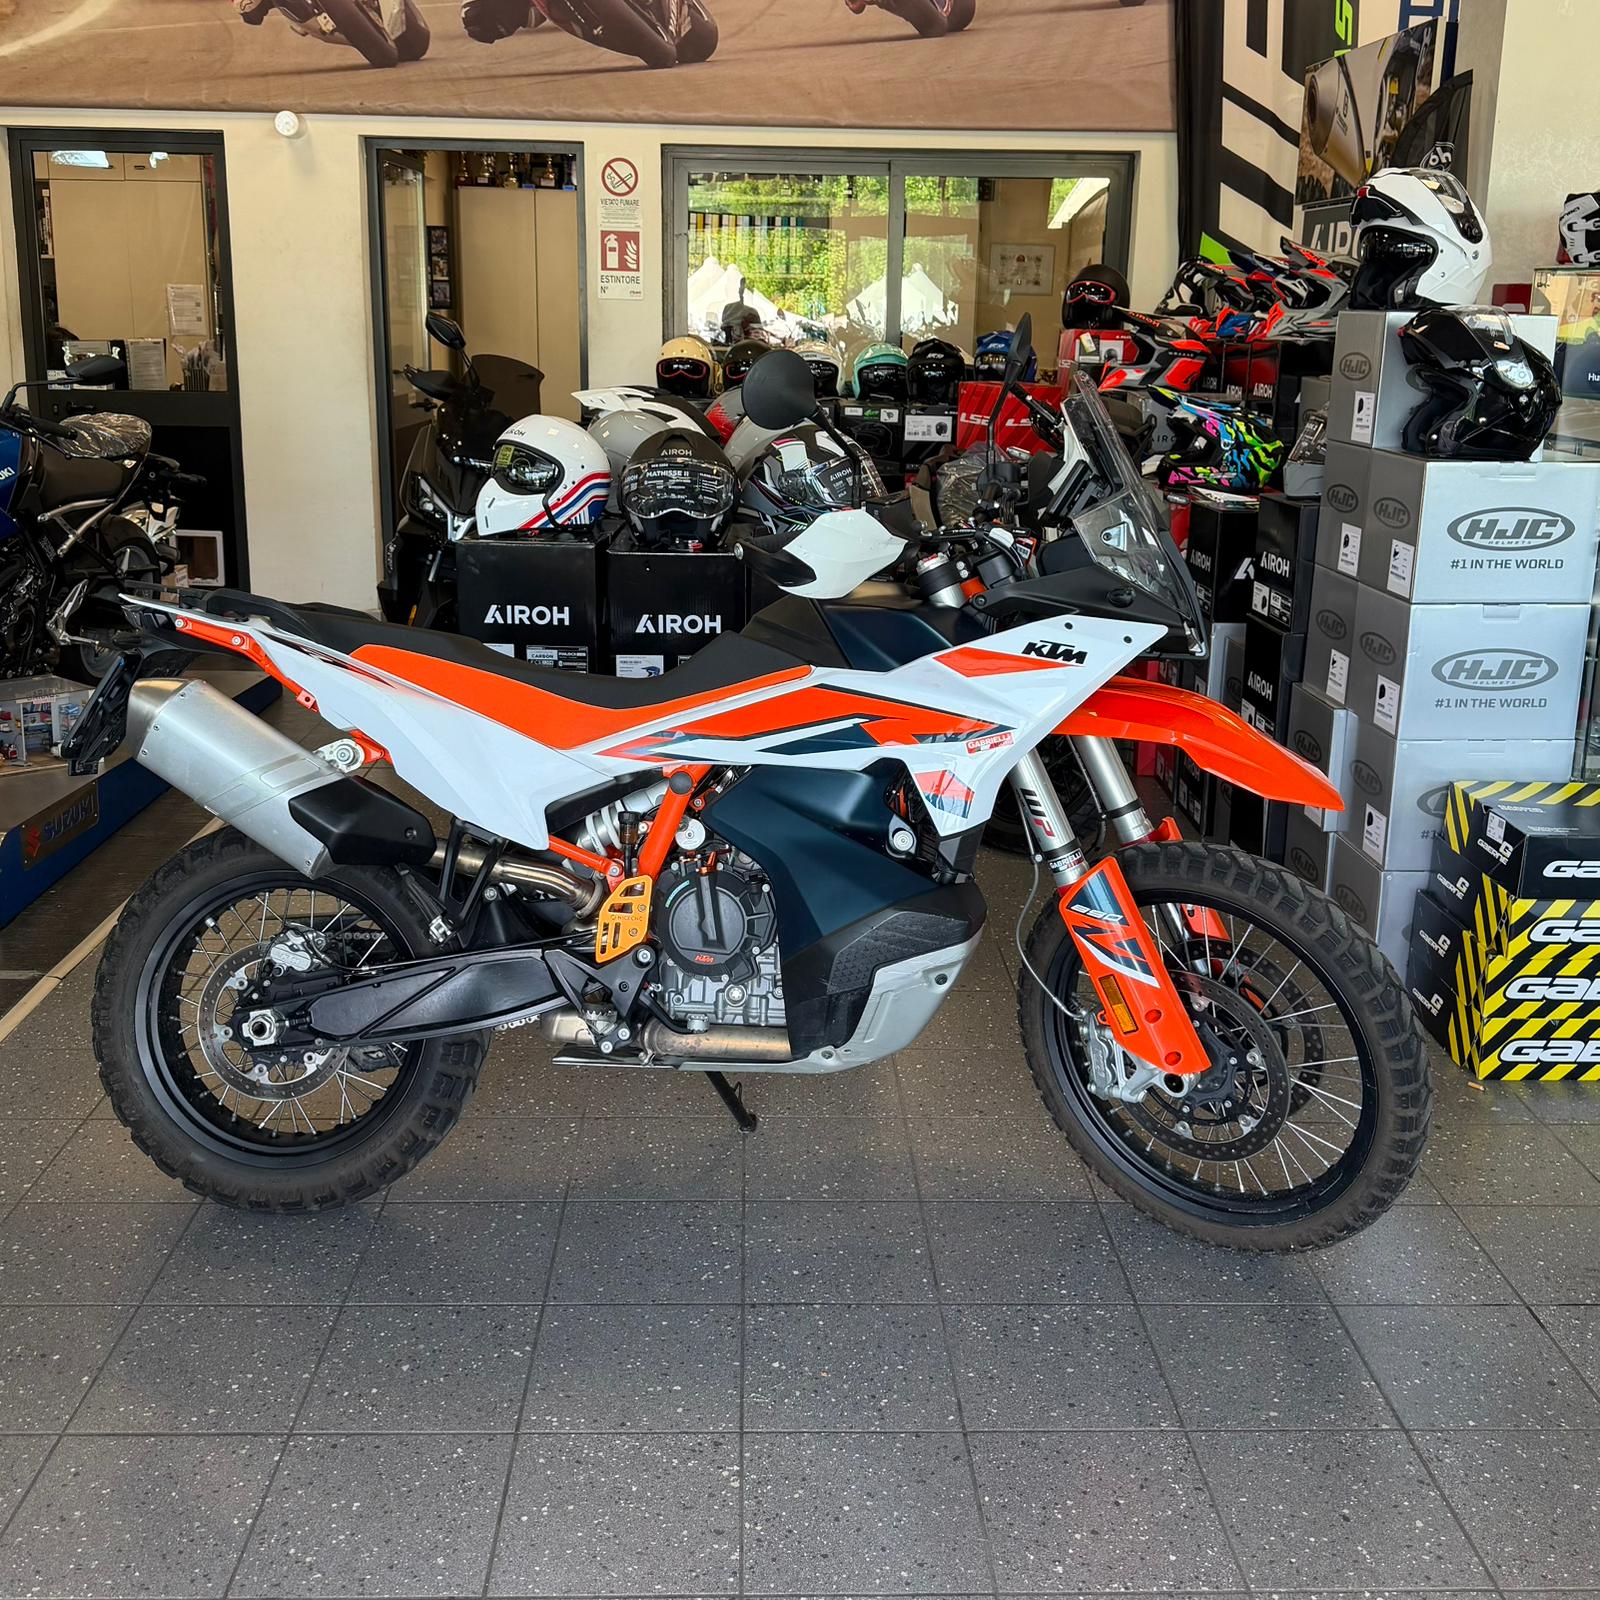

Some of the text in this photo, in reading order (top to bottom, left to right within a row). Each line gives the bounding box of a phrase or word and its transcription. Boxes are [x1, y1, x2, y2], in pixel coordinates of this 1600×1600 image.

[600, 275, 640, 284] ESTINTORE
[1342, 359, 1368, 374] HJC
[1252, 383, 1273, 399] AIROH
[660, 448, 692, 456] AIROH
[829, 468, 852, 482] AIROH
[1330, 489, 1355, 508] HJC
[1378, 503, 1406, 523] HJC
[1462, 518, 1560, 540] HJC
[1190, 549, 1212, 573] AIROH
[1260, 551, 1290, 578] AIROH
[1450, 559, 1564, 569] #1 IN THE WORLD
[484, 604, 570, 626] AIROH
[635, 614, 722, 634] AIROH
[1319, 614, 1344, 636] HJC
[1021, 640, 1088, 664] KTM
[1363, 636, 1392, 661] HJC
[1447, 659, 1544, 680] HJC
[1247, 671, 1273, 702] AIROH
[1435, 698, 1548, 708] #1 IN THE WORLD
[968, 733, 1012, 749] GABRIELLI
[1298, 734, 1319, 758] HJC
[1353, 763, 1380, 791] HJC
[43, 793, 95, 842] SUZUKI
[1049, 851, 1082, 870] GABRIELLI
